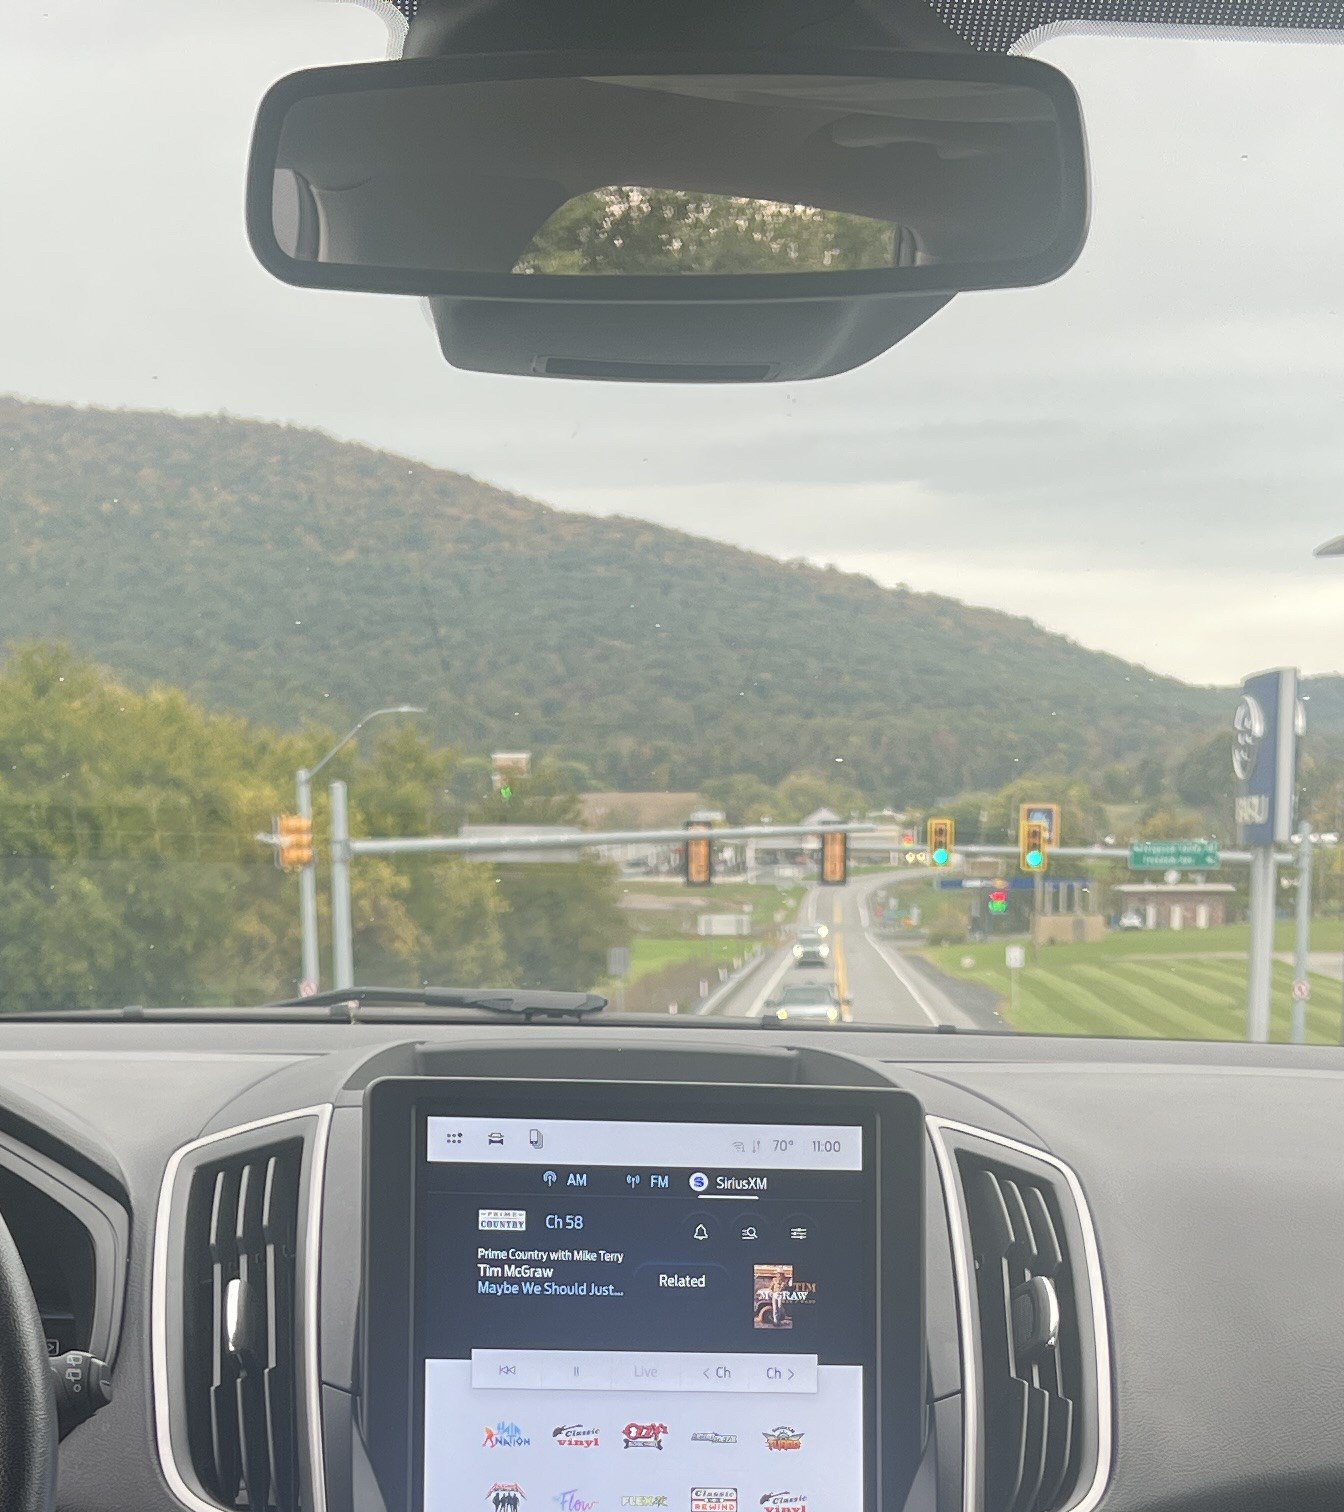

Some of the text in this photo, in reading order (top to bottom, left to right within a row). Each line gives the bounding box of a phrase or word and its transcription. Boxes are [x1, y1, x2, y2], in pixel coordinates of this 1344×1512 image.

[812, 1140, 841, 1153] 11:00
[567, 1174, 587, 1187] AM
[650, 1175, 669, 1188] FM
[716, 1176, 768, 1190] SiriusXM
[480, 1220, 524, 1229] COUNTRY
[545, 1215, 584, 1230] Ch 58
[477, 1248, 624, 1264] Prime Country with Mike Terry
[477, 1264, 554, 1278] Tim McGraw
[659, 1274, 706, 1288] Related
[793, 1282, 817, 1293] TIM
[477, 1281, 519, 1295] Maybe
[522, 1282, 541, 1295] We
[544, 1282, 586, 1296] Should
[634, 1364, 658, 1379] Live
[715, 1366, 731, 1380] Ch
[766, 1366, 782, 1380] Ch
[565, 1428, 600, 1438] Classic
[495, 1436, 531, 1448] NATION
[557, 1438, 600, 1449] vinyl
[694, 1489, 735, 1498] Classic
[771, 1495, 807, 1505] Classic
[560, 1489, 599, 1512] Flow
[694, 1503, 735, 1512] REWIND
